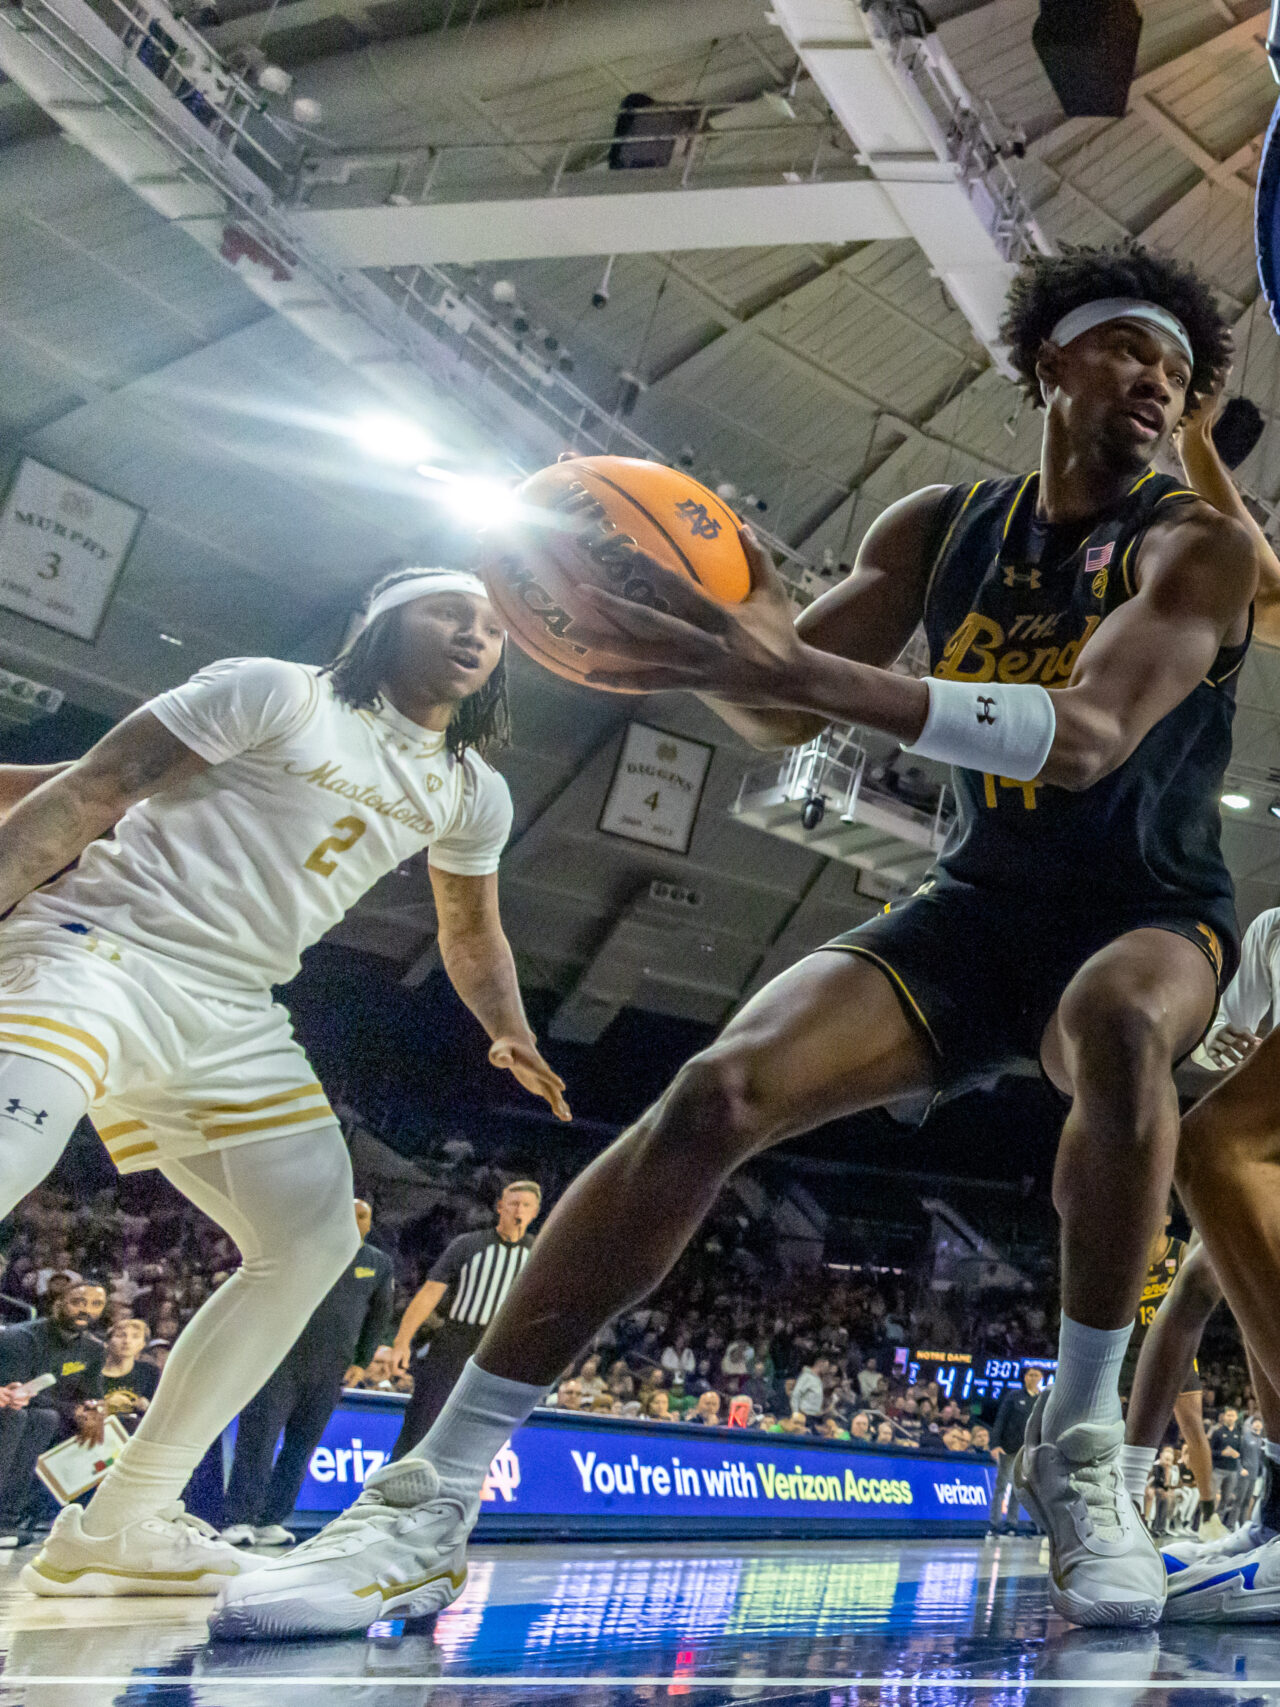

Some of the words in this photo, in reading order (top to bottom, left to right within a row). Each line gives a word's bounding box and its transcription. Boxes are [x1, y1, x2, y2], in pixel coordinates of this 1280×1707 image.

[37, 551, 62, 580] 3
[932, 611, 1102, 684] Bend
[283, 759, 436, 835] Mastodons
[643, 791, 660, 811] 4
[304, 815, 367, 878] 2
[916, 1350, 945, 1361] NOTRE
[947, 1352, 973, 1363] DAME
[985, 1359, 1020, 1378] 13:07
[937, 1365, 975, 1400] 41
[309, 1438, 388, 1483] eriz
[570, 1450, 672, 1496] You're
[672, 1457, 700, 1497] in
[701, 1461, 759, 1498] with
[757, 1462, 842, 1502] Verizon
[844, 1468, 914, 1505] Access
[933, 1478, 988, 1506] verizon
